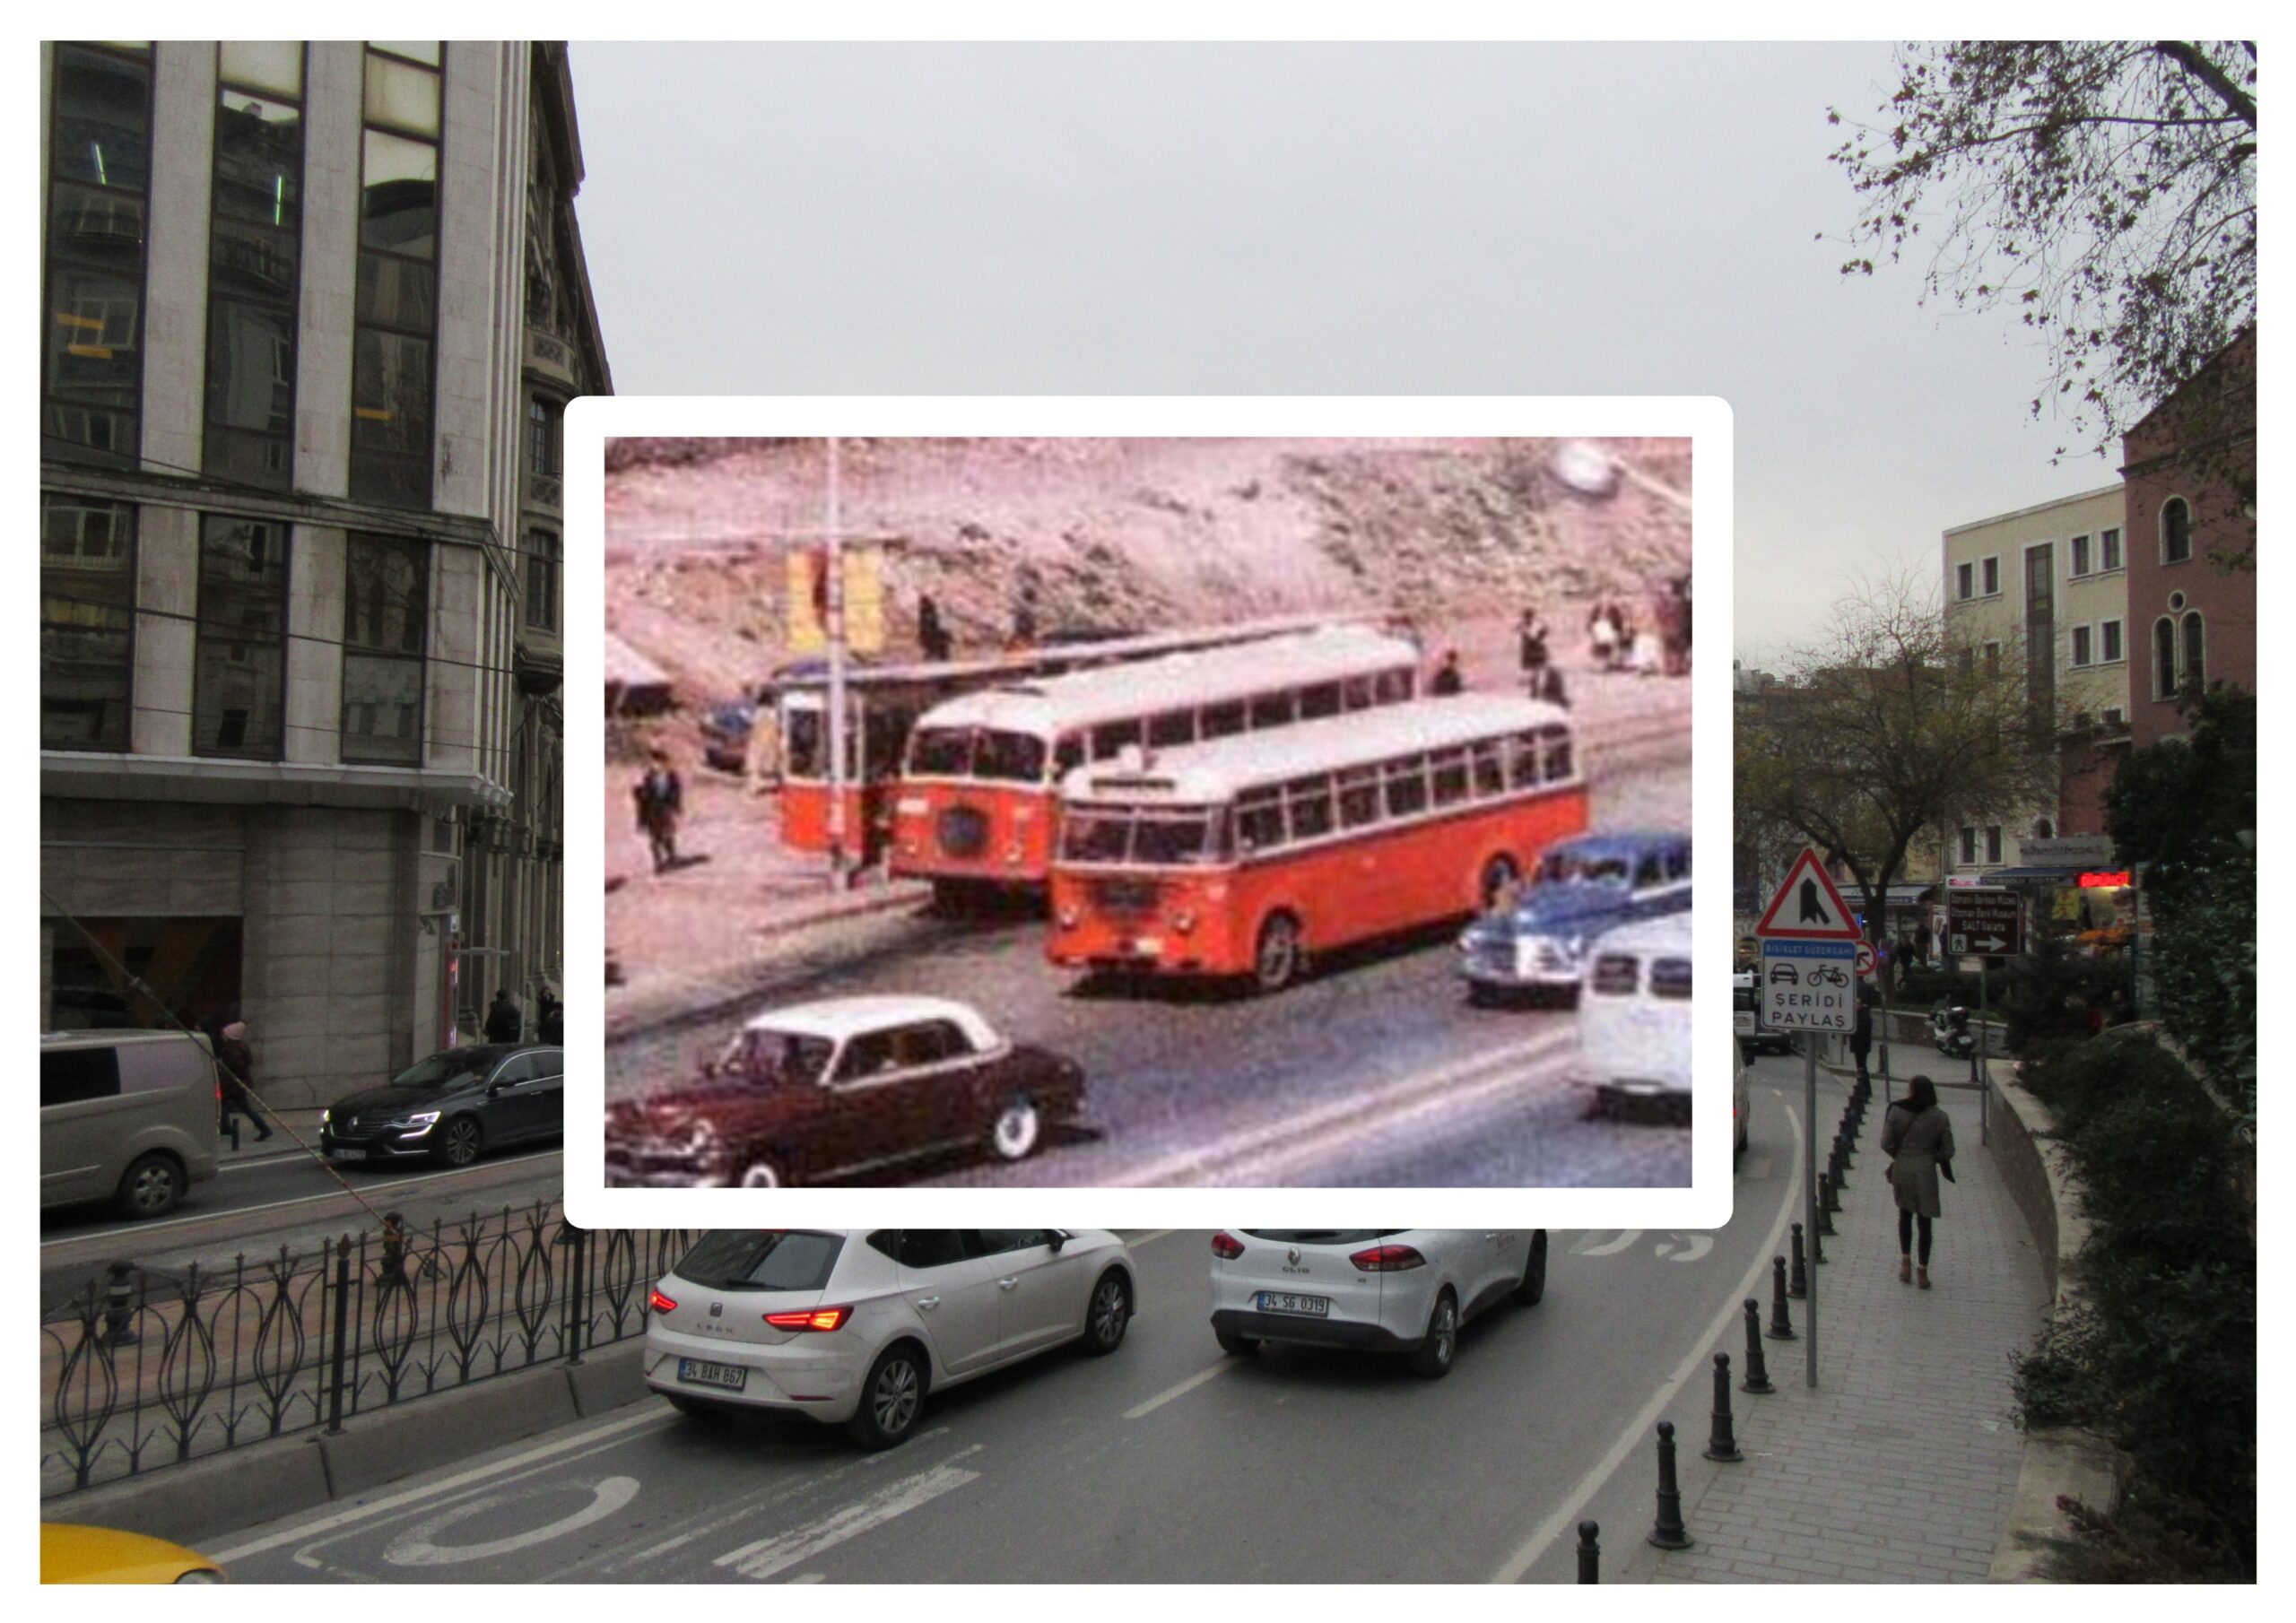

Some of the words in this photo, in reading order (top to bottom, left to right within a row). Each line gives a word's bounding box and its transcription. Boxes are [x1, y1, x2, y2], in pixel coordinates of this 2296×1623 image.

[1776, 992, 1842, 1009] ŞERİDİ
[1772, 1011, 1845, 1028] PAYLAŞ
[1265, 1294, 1277, 1306] 34
[1283, 1296, 1295, 1308] SG
[1300, 1298, 1325, 1311] 0319
[687, 1362, 698, 1377] 34
[701, 1365, 721, 1381] BAH
[723, 1367, 743, 1384] 867
